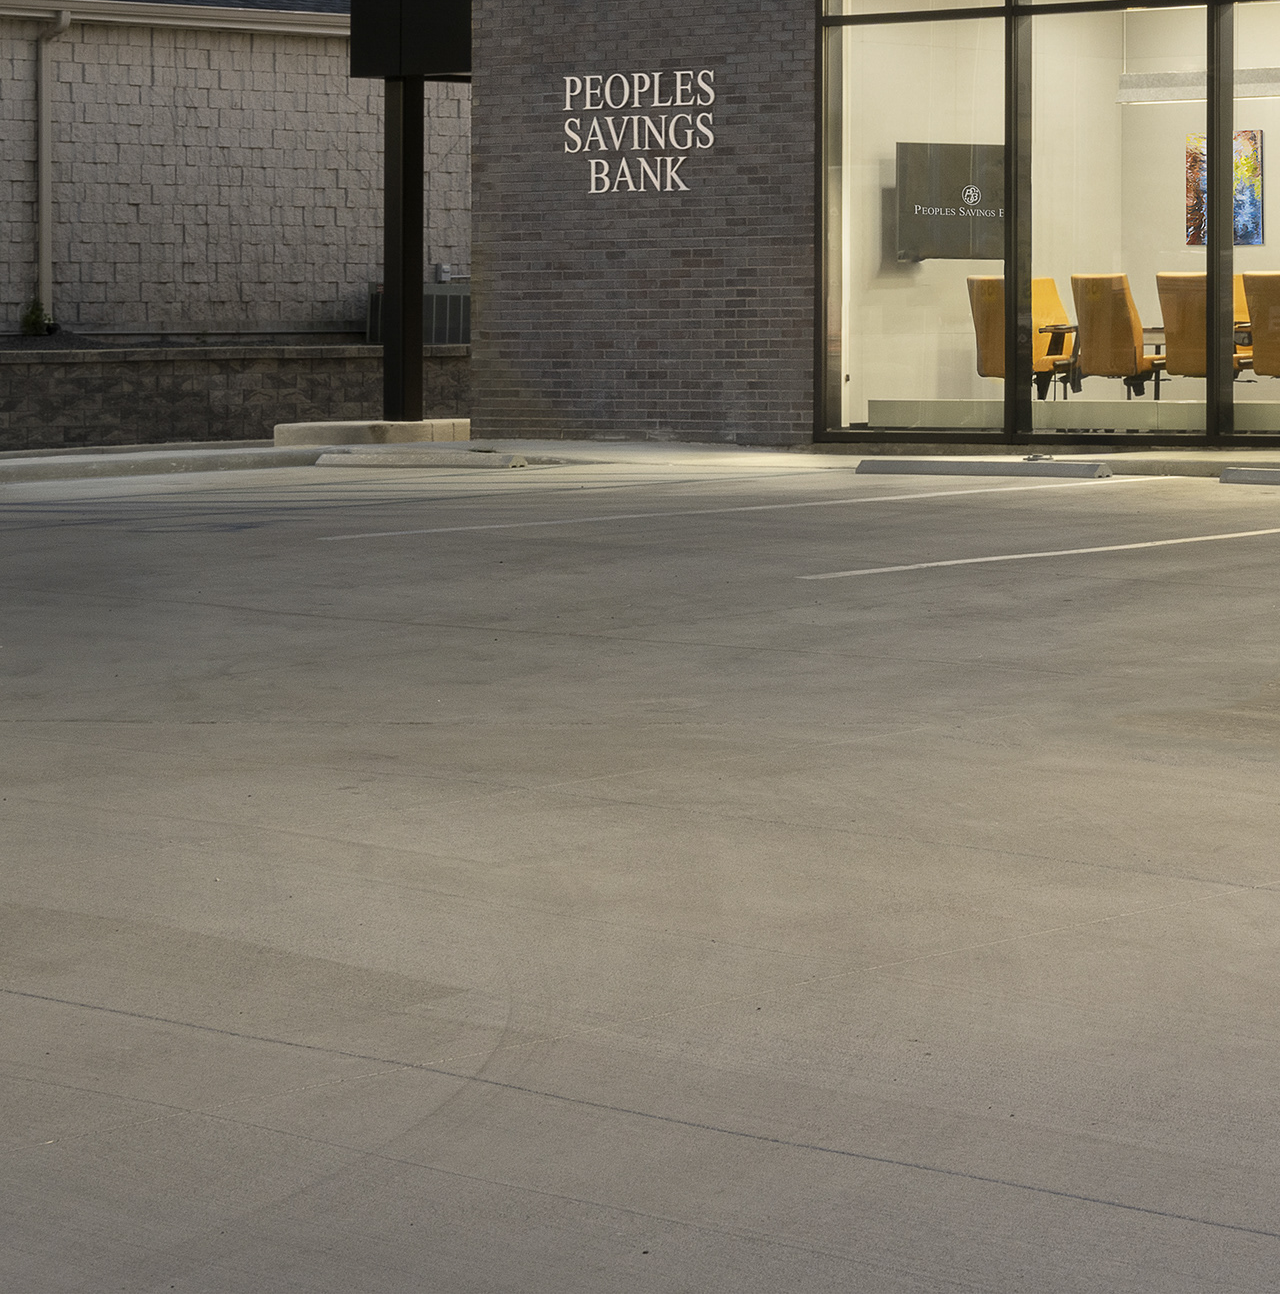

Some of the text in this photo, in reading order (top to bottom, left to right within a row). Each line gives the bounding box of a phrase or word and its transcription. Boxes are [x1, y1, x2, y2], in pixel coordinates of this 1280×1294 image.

[563, 70, 715, 111] PEOPLES
[564, 112, 715, 153] SAVINGS
[588, 156, 690, 194] BANK
[914, 204, 956, 216] PEOPLES
[959, 206, 996, 218] SAVINGS
